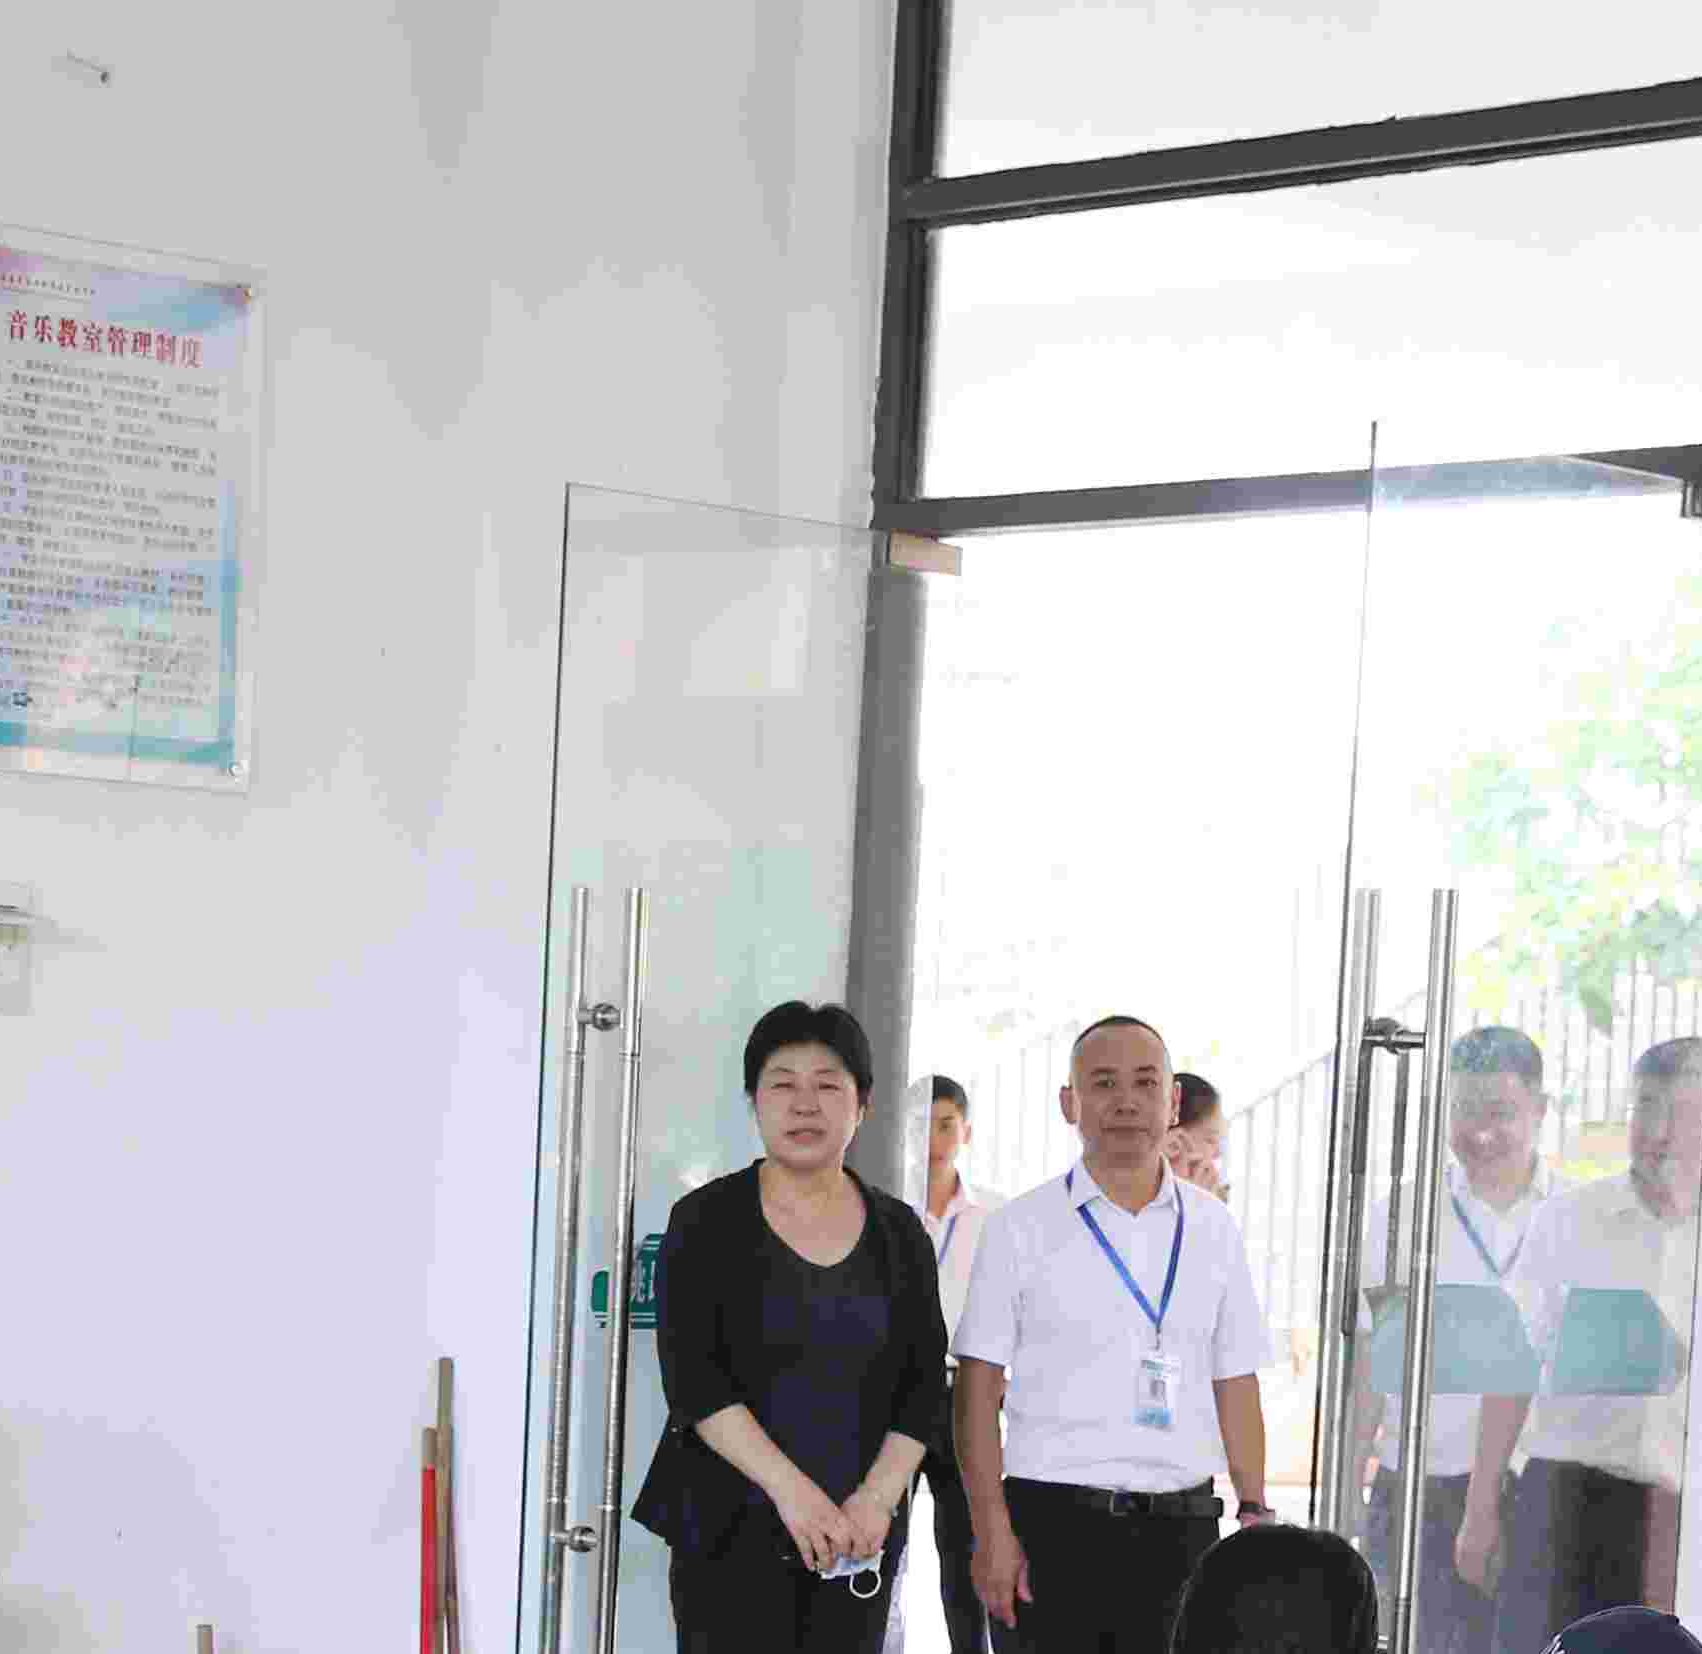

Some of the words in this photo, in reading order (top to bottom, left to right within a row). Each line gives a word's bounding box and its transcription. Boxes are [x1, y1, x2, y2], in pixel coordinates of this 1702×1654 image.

[8, 309, 203, 368] 音乐教室管理制度
